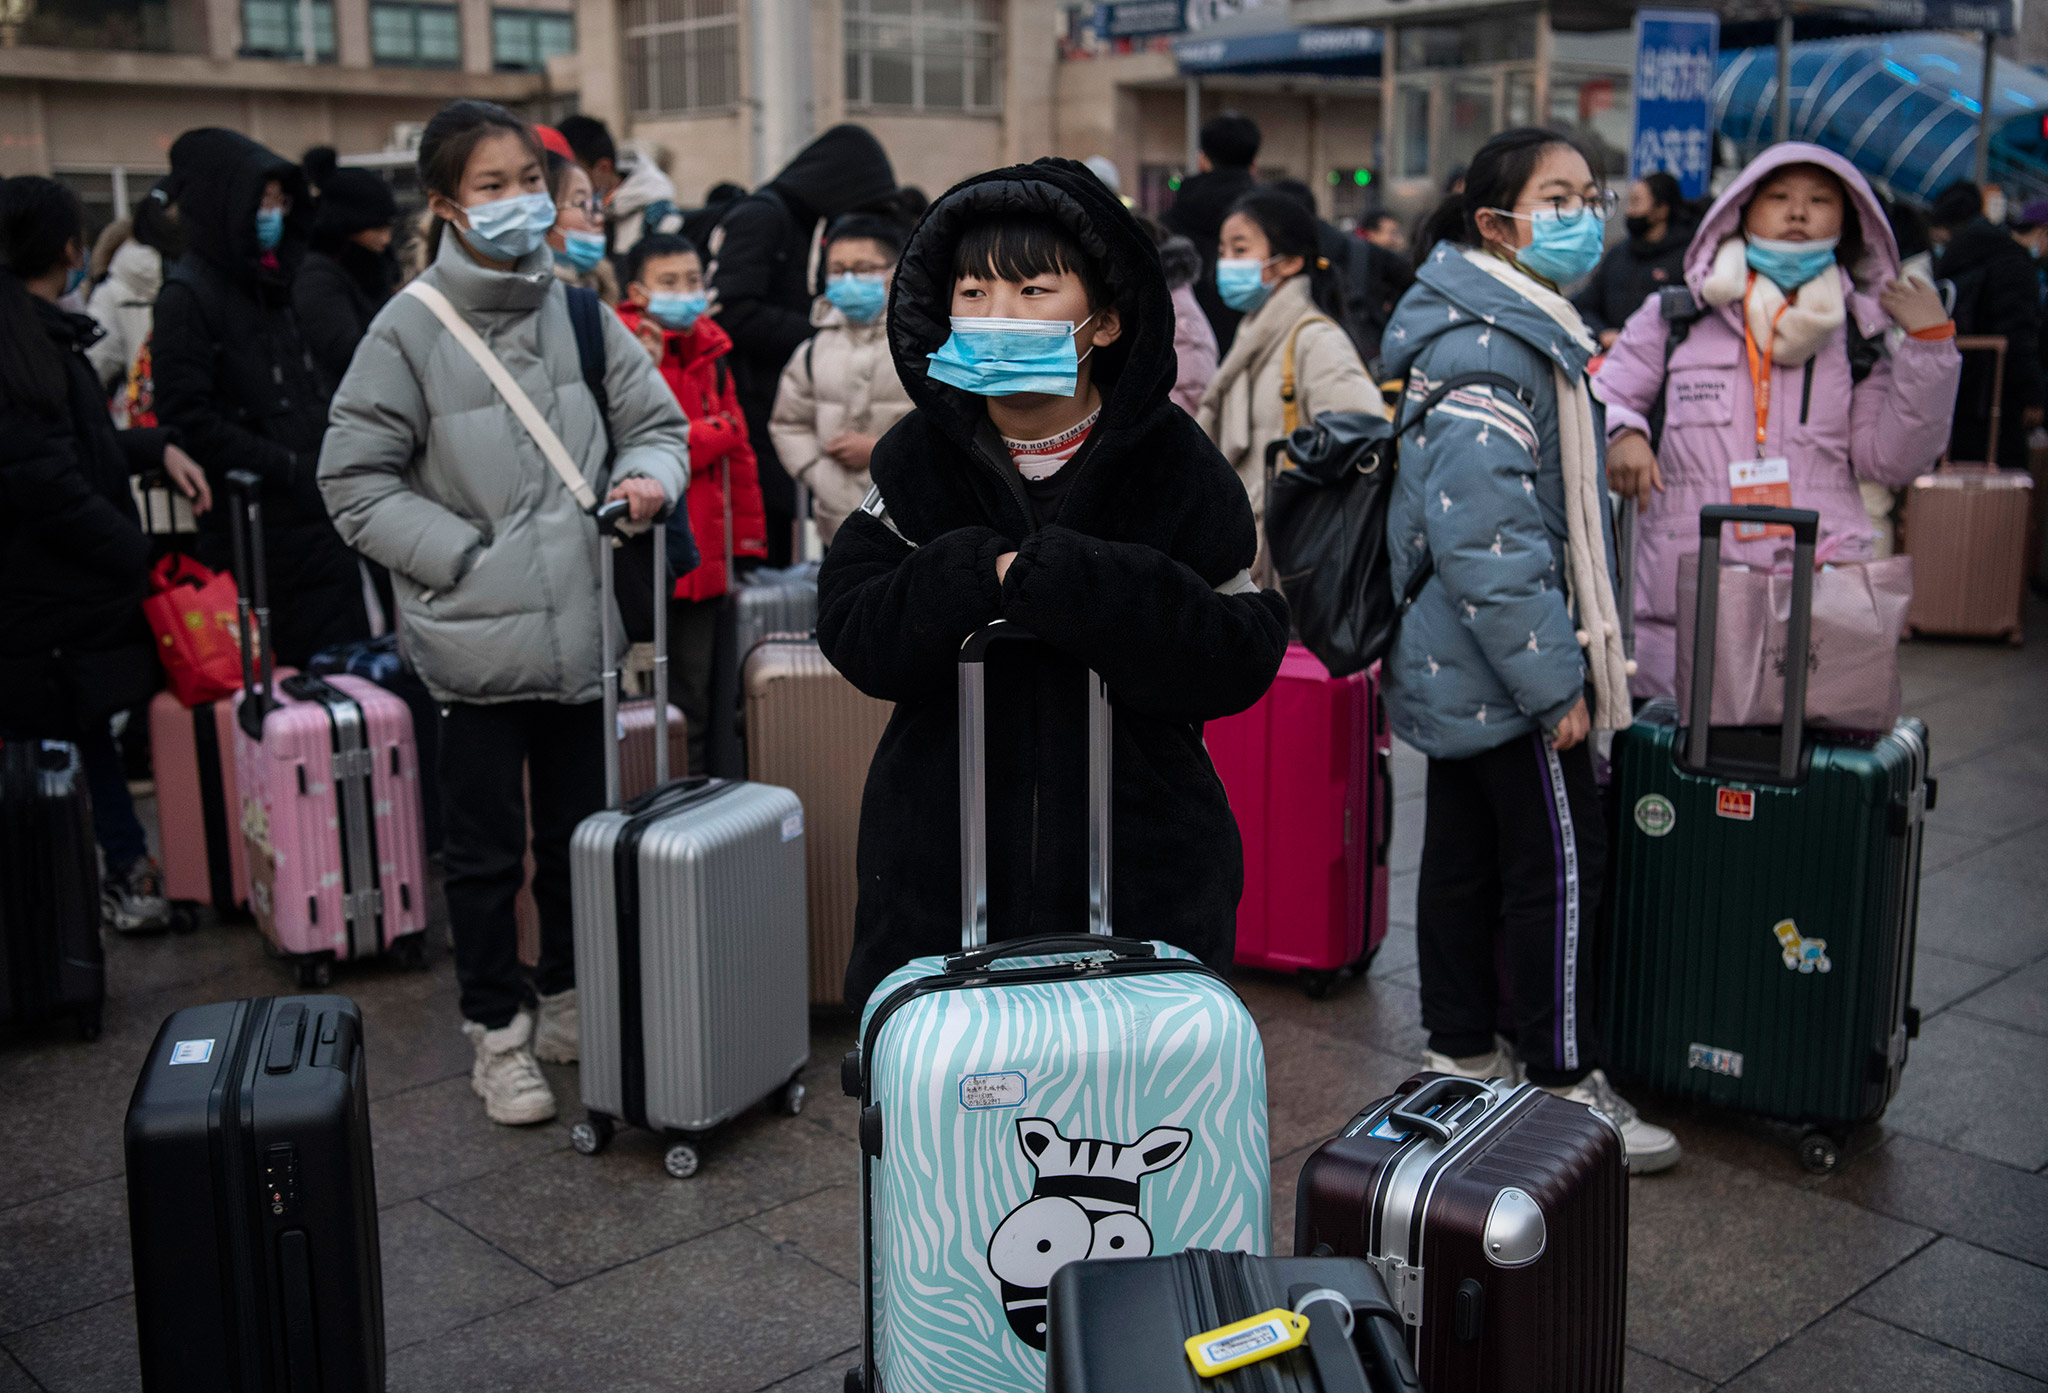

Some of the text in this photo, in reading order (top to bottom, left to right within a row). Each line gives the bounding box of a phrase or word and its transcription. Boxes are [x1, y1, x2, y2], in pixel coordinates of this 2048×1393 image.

[1005, 441, 1027, 449] 1978
[1030, 439, 1055, 449] HOPE
[1059, 424, 1085, 440] TIME
